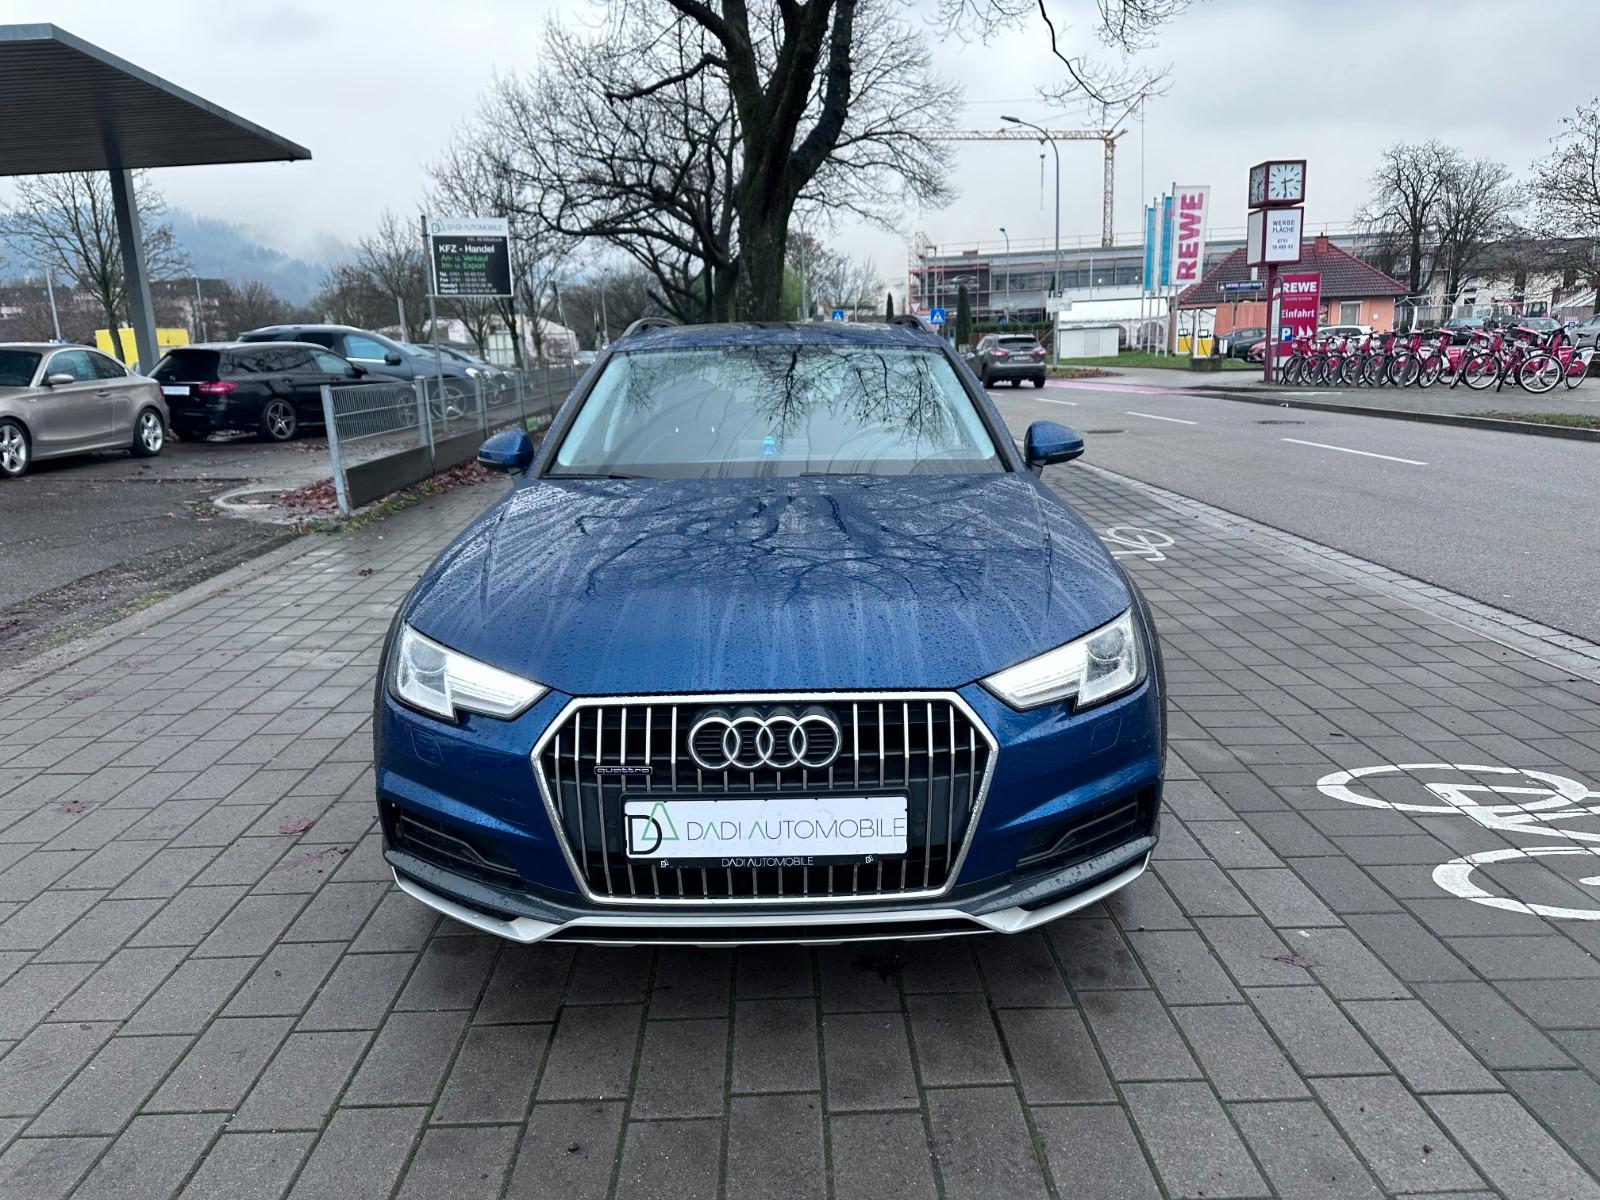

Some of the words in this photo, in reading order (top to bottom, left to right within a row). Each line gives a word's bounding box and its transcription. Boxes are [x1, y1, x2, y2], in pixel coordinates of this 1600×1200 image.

[1176, 192, 1204, 280] REWE
[439, 244, 457, 253] KFZ
[464, 244, 495, 253] Handel
[463, 254, 488, 262] Verkauf
[463, 262, 486, 270] Export
[1282, 281, 1318, 294] REWE
[1281, 309, 1315, 319] Einfahrt
[1281, 327, 1292, 341] P
[686, 821, 742, 841] DADI
[748, 817, 908, 841] AUTOMOBILE
[721, 858, 746, 868] DADI
[747, 856, 815, 868] AUTOMOBILE
